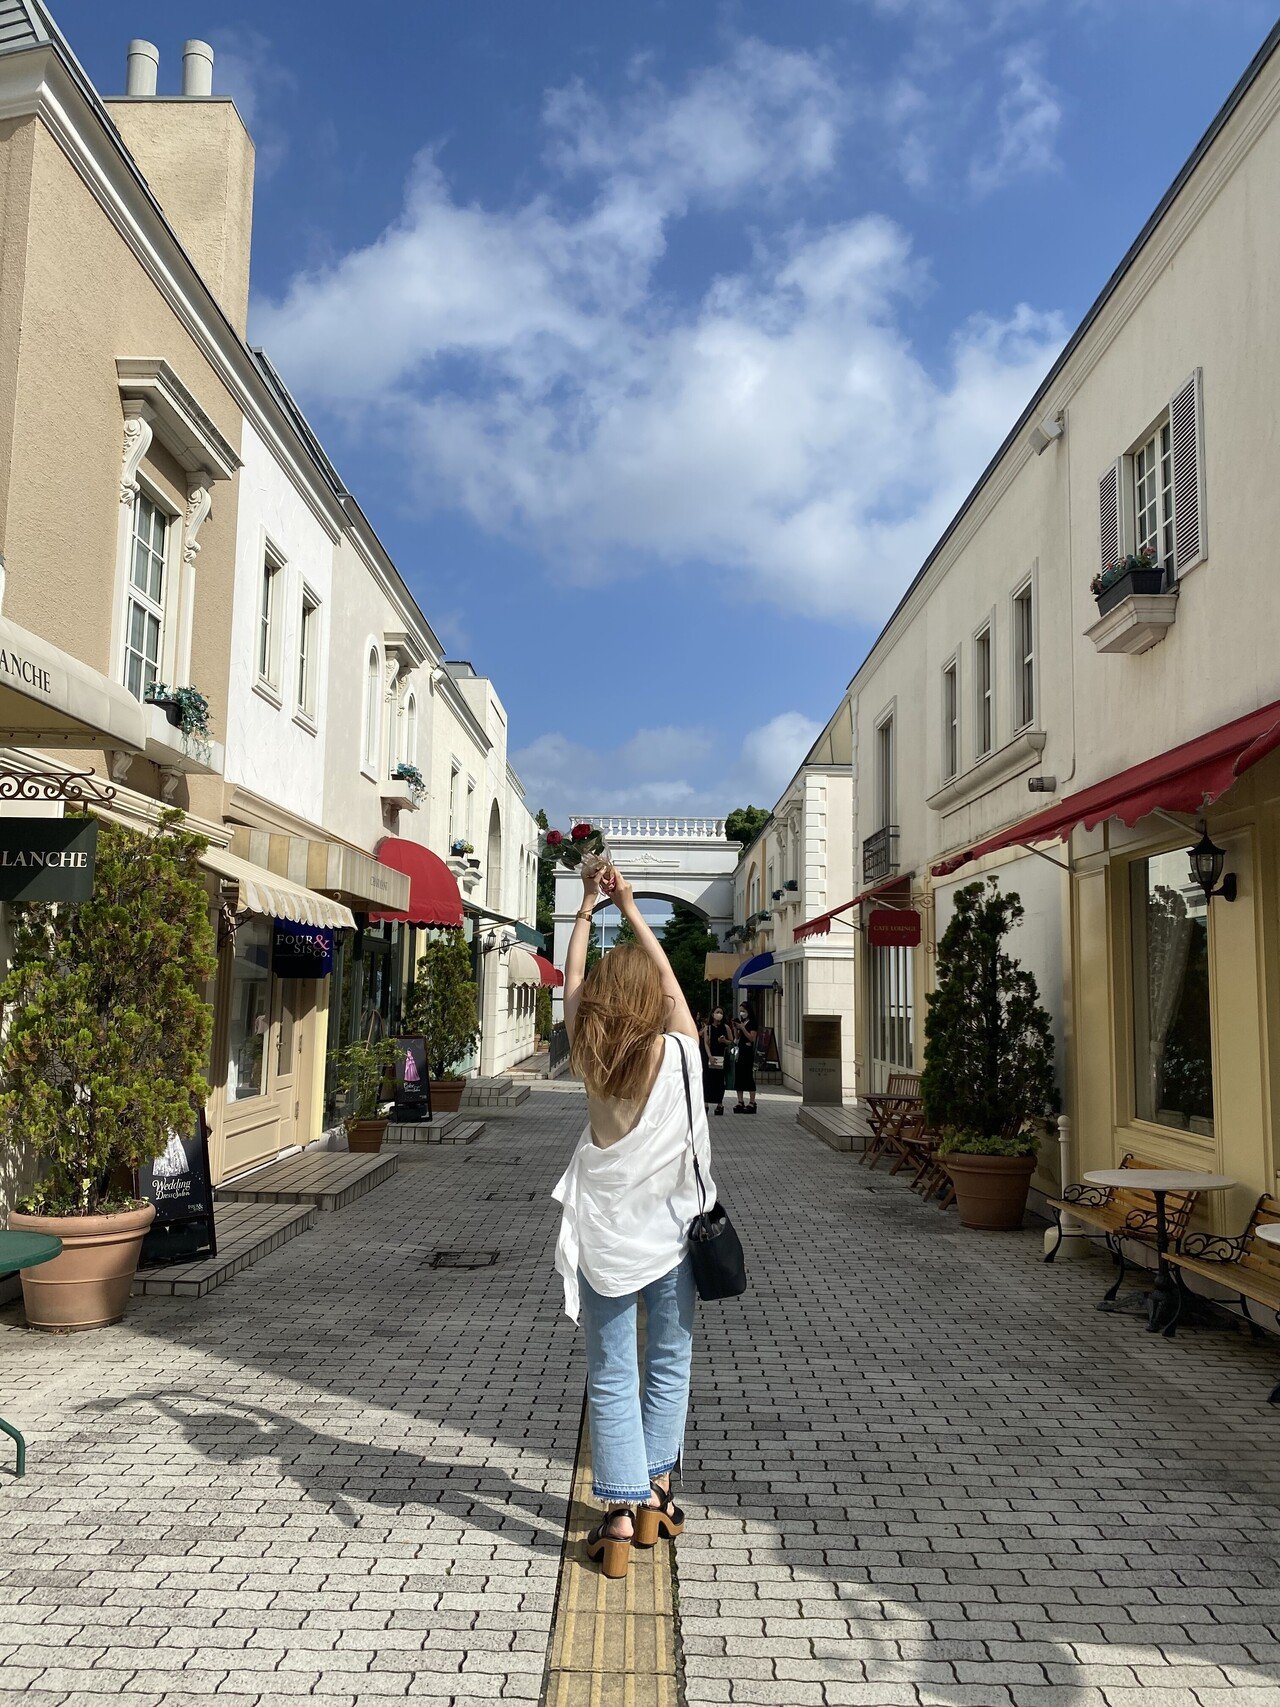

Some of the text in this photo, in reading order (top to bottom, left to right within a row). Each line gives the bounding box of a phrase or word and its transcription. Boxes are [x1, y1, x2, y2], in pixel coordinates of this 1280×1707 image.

[0, 649, 51, 693] ANCHE
[1, 850, 88, 868] LANCHE
[152, 1177, 191, 1191] Wedding
